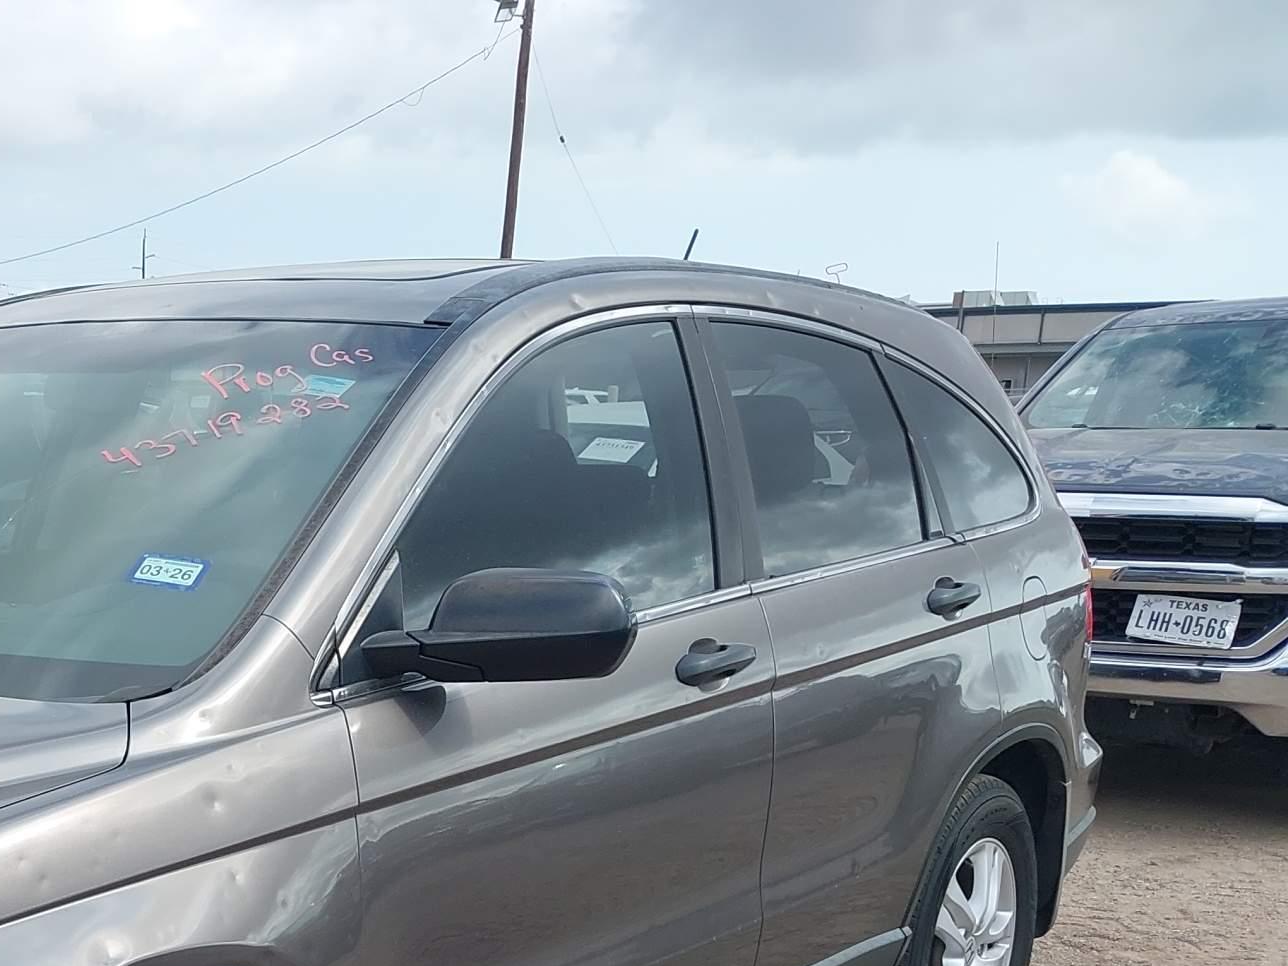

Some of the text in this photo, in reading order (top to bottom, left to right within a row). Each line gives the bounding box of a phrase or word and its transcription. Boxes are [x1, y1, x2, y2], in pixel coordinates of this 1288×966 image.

[201, 363, 308, 400] Prog
[310, 343, 374, 367] Cas
[1169, 599, 1209, 613] TEXAS
